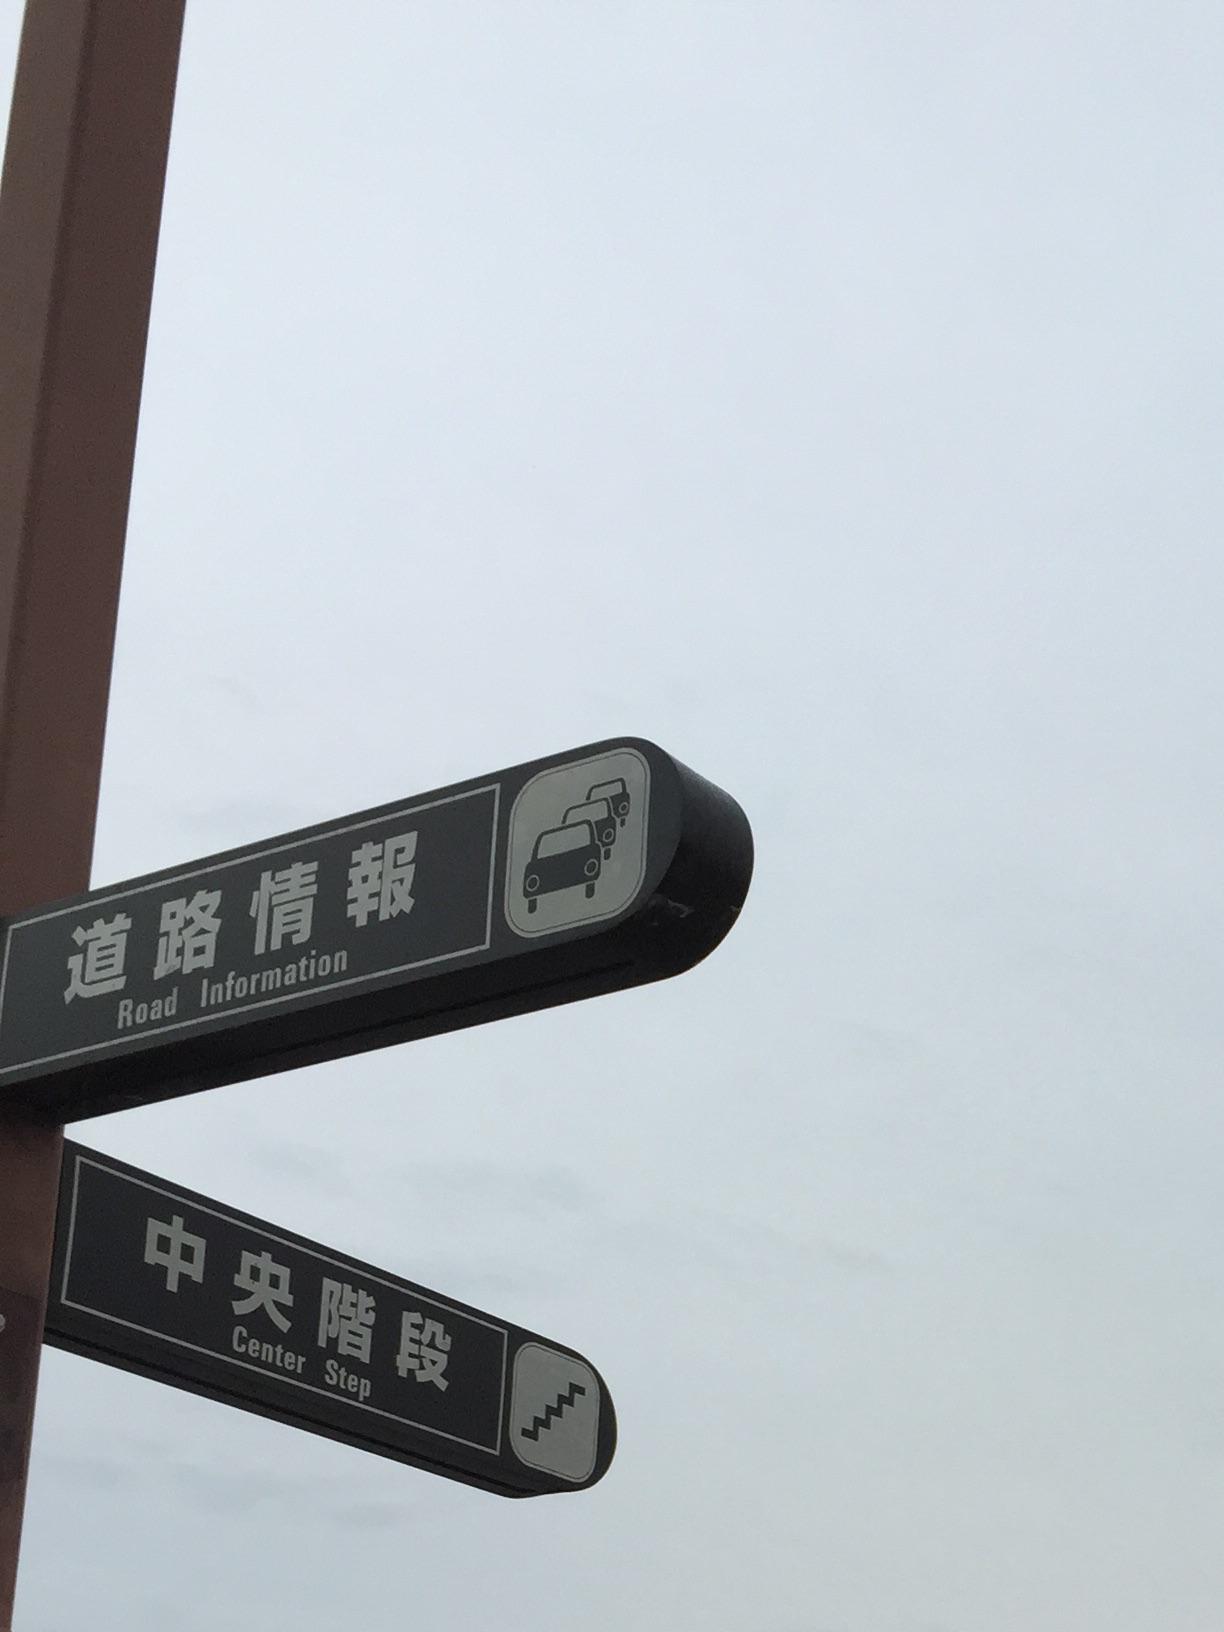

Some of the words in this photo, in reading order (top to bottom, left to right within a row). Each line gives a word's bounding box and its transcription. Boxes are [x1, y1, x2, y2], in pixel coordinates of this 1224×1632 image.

[64, 831, 418, 1004] 道路情報
[117, 987, 178, 1029] Road
[200, 949, 347, 1007] Information
[144, 1215, 452, 1391] 中央階段
[232, 1326, 306, 1374] Center
[325, 1359, 371, 1401] Step
